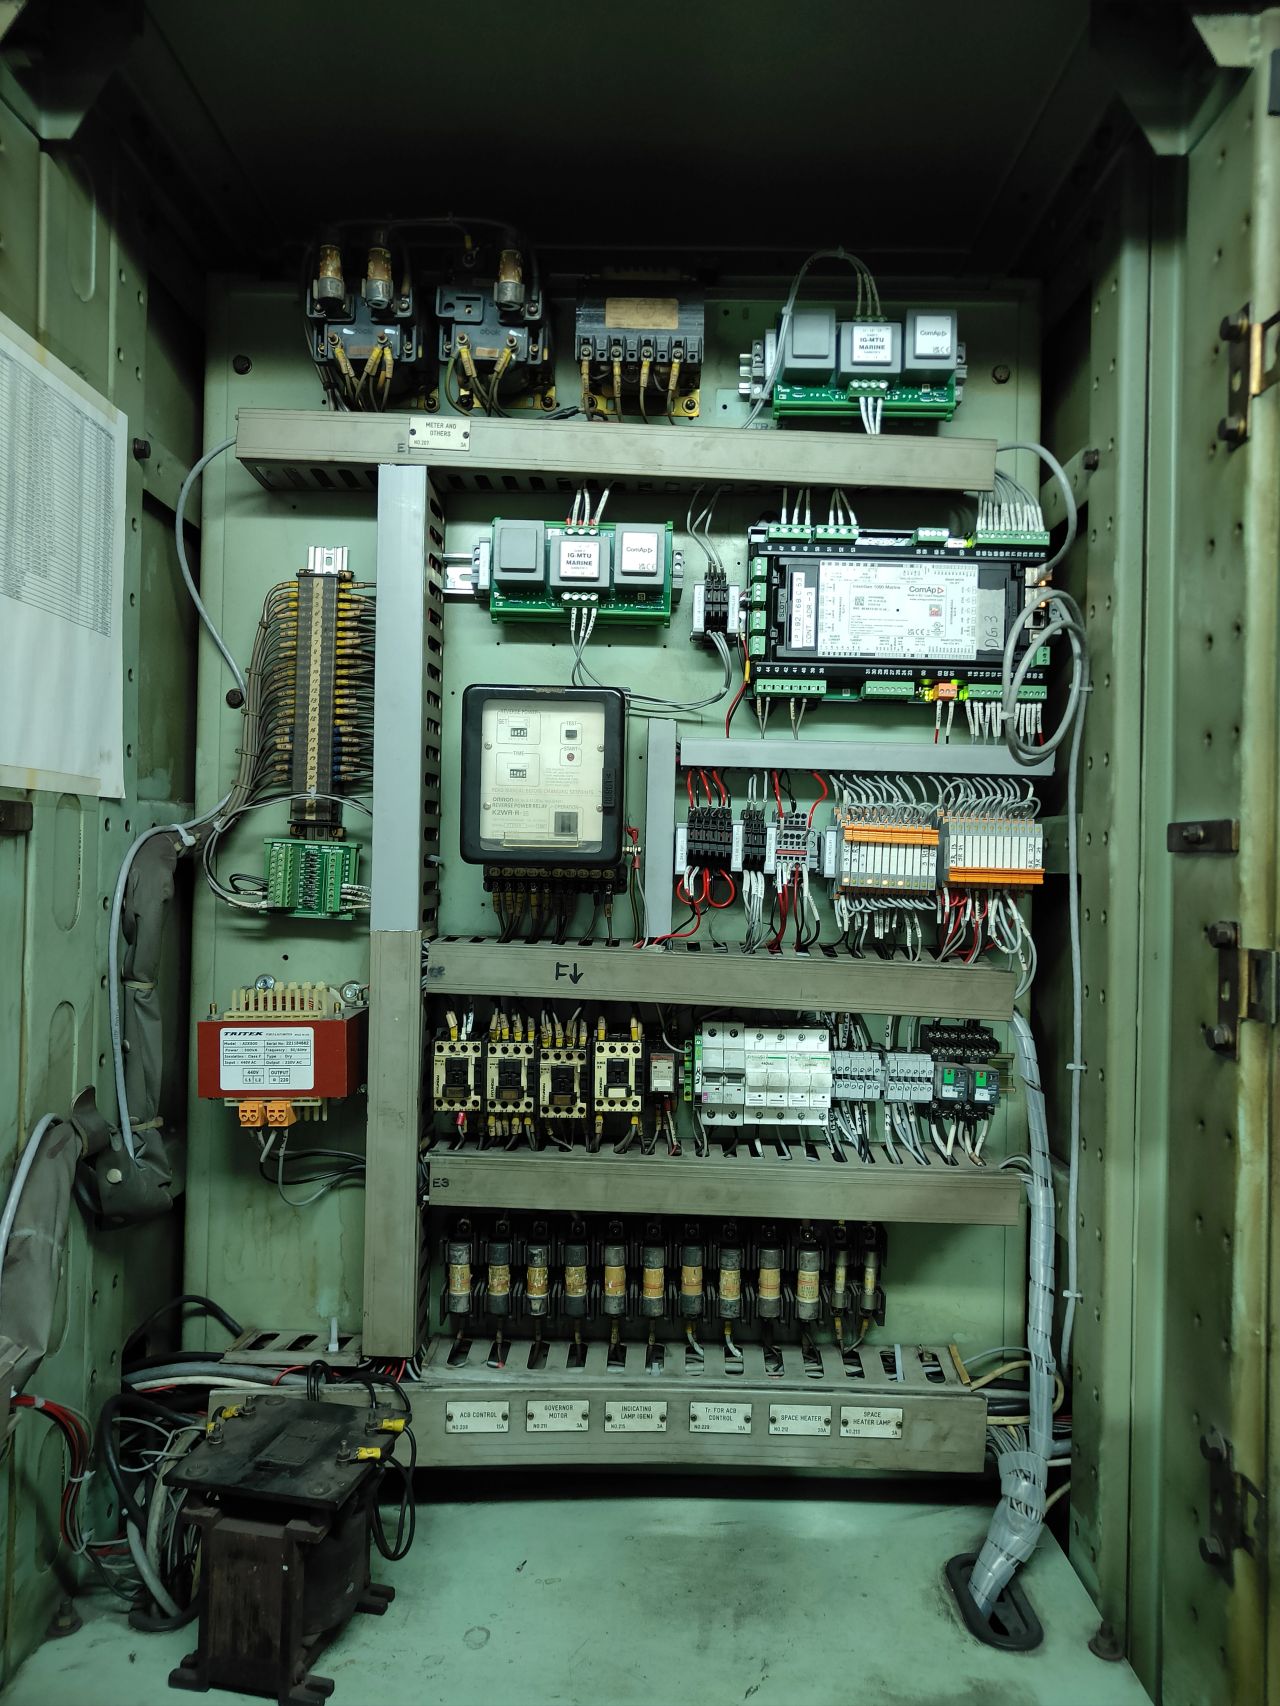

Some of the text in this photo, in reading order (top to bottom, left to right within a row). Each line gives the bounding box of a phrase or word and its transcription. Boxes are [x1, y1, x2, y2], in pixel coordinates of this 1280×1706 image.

[397, 443, 406, 452] E
[555, 962, 569, 980] F
[432, 1178, 449, 1188] E3
